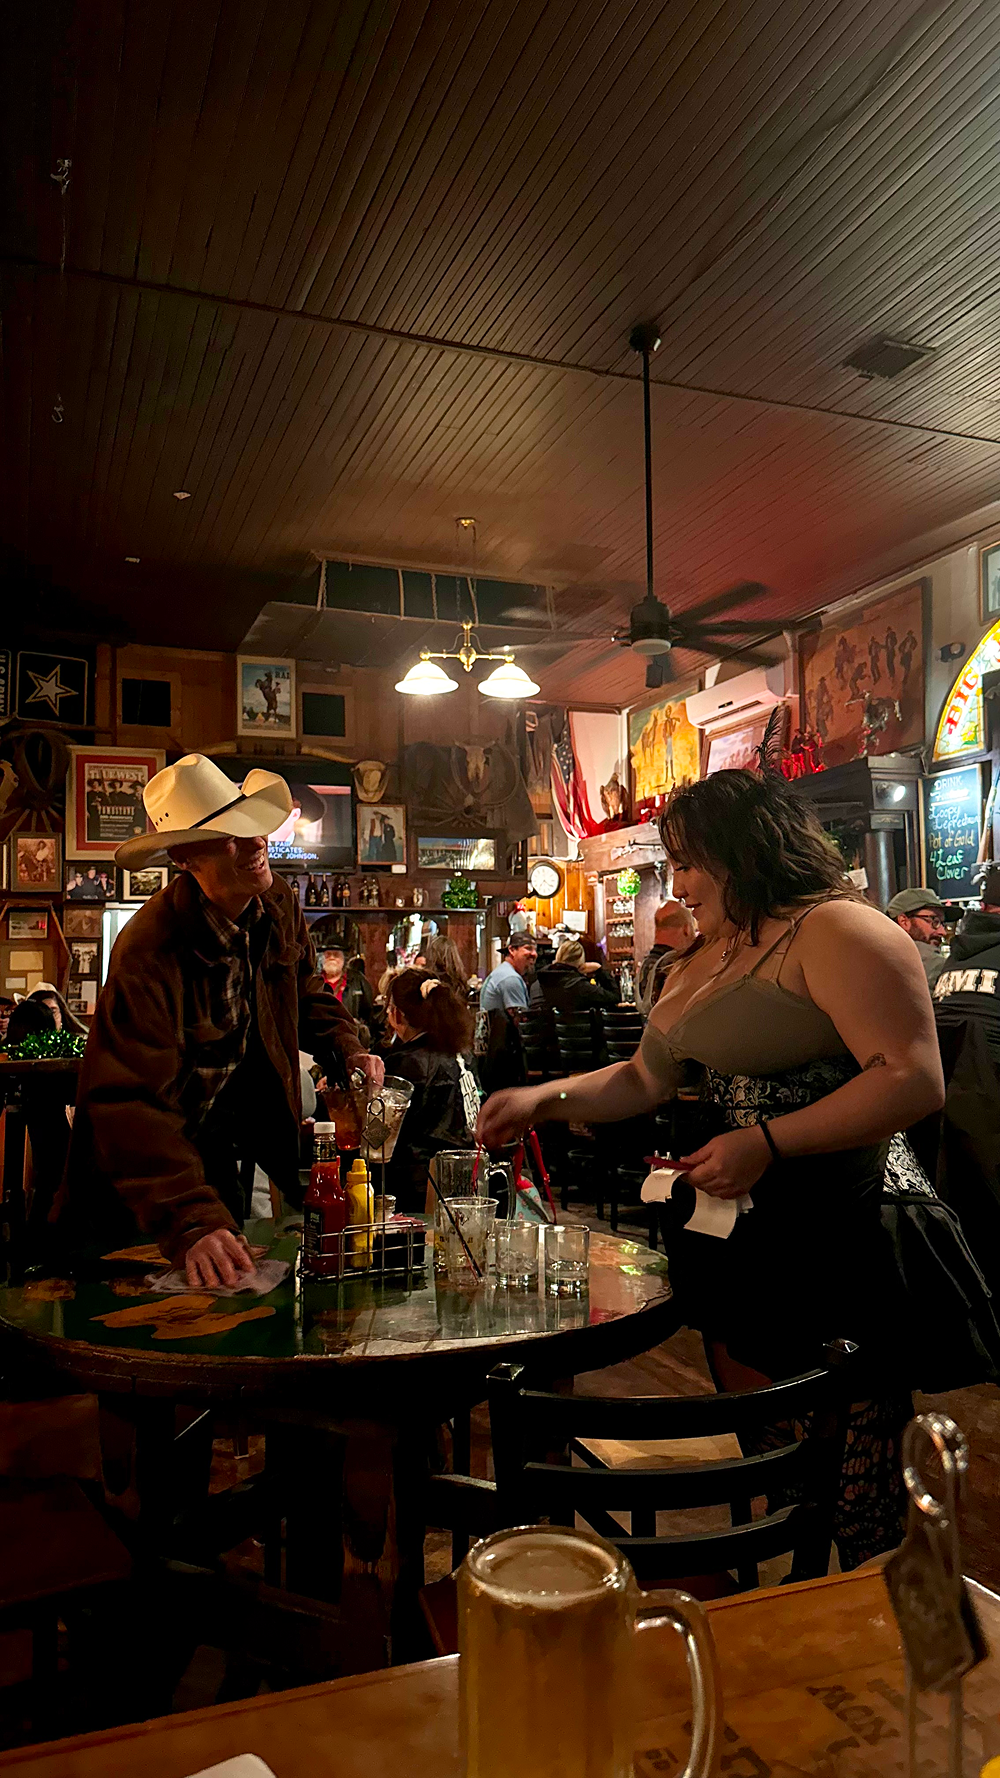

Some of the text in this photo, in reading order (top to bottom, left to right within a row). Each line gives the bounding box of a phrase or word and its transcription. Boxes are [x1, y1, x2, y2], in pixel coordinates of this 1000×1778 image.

[945, 667, 979, 735] BIG
[933, 776, 963, 790] DRINK
[928, 805, 961, 822] Loopy
[929, 829, 975, 849] Pot of Gold
[930, 848, 965, 868] 4 Leaf
[936, 866, 969, 880] Clover
